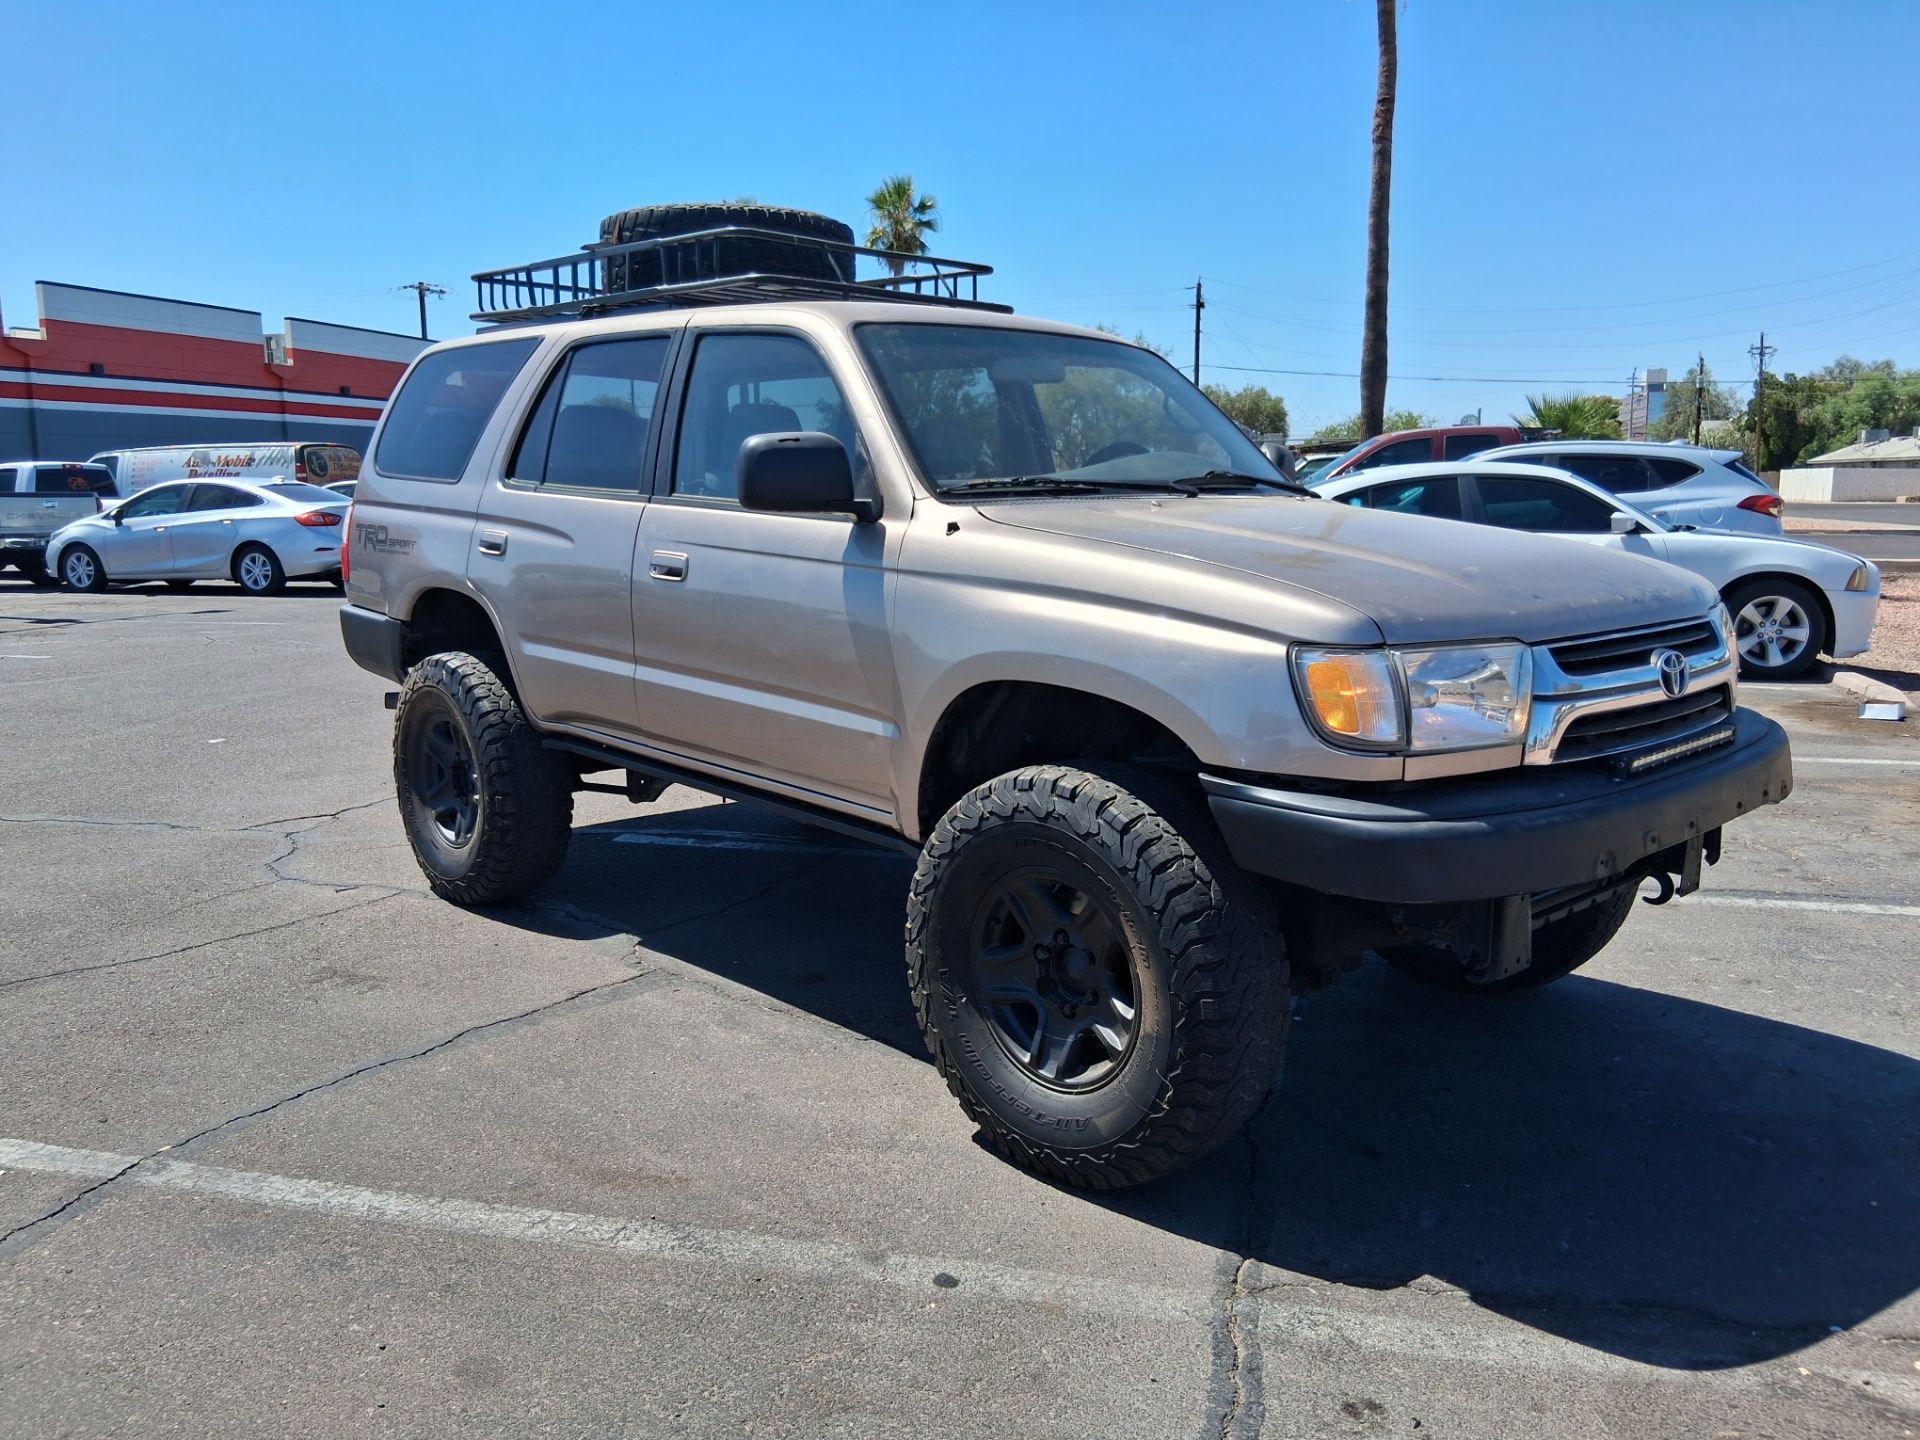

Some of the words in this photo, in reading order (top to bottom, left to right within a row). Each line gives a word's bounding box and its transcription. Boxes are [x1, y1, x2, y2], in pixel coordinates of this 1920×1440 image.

[181, 455, 216, 468] Auo
[355, 523, 388, 551] TRD
[388, 538, 416, 550] SPORT
